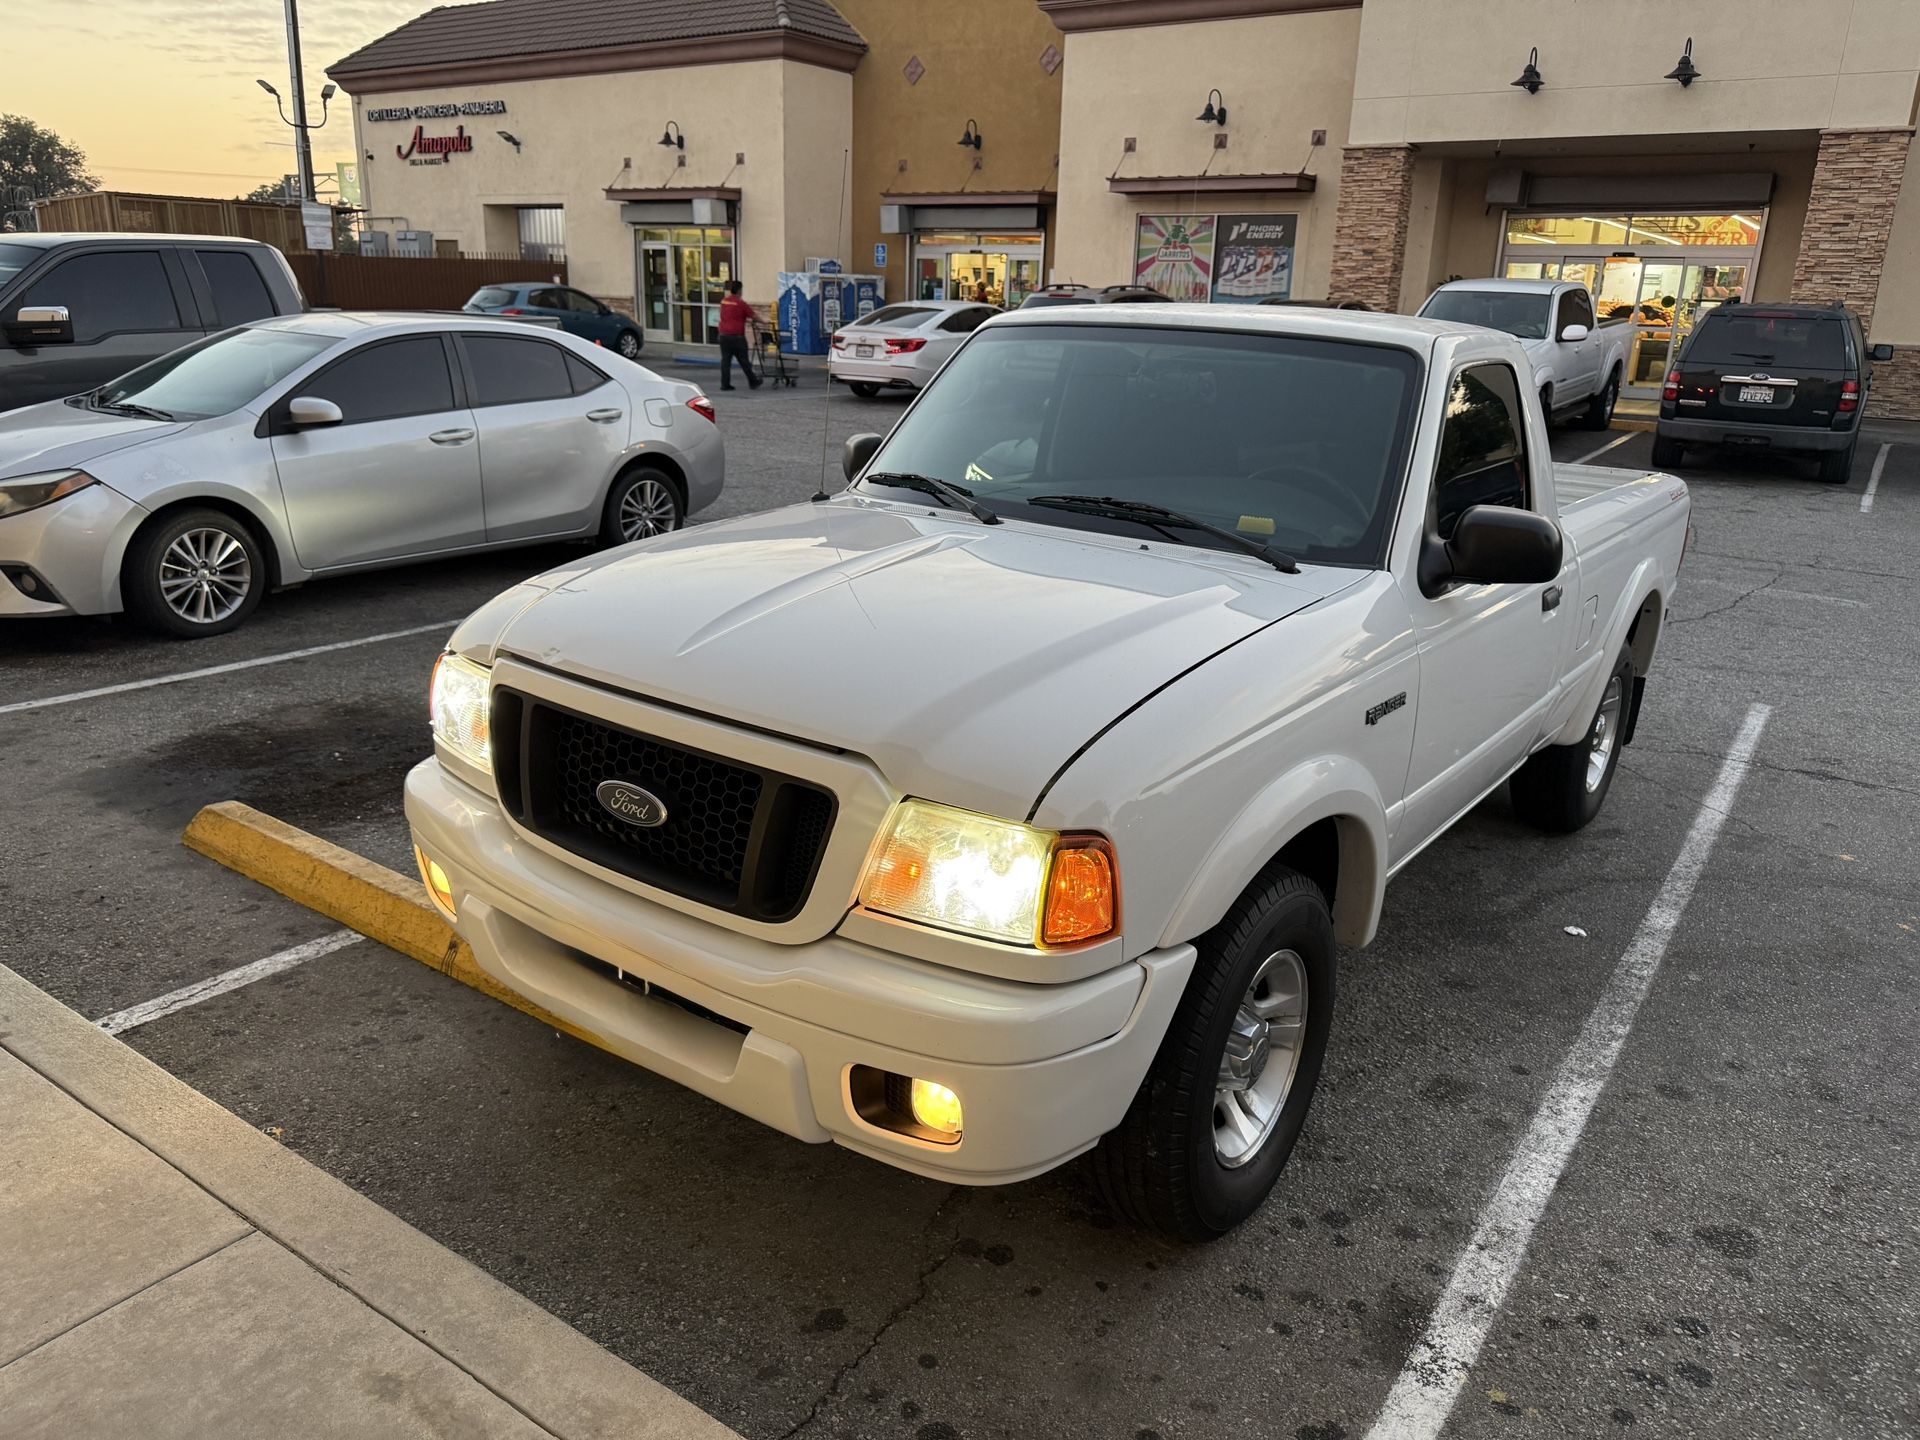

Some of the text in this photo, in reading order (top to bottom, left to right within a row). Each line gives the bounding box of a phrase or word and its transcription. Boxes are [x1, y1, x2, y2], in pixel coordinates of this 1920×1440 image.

[461, 100, 506, 115] PANADERIA
[397, 125, 473, 163] Amapola
[1365, 692, 1406, 725] RANGER
[611, 788, 650, 820] Ford
